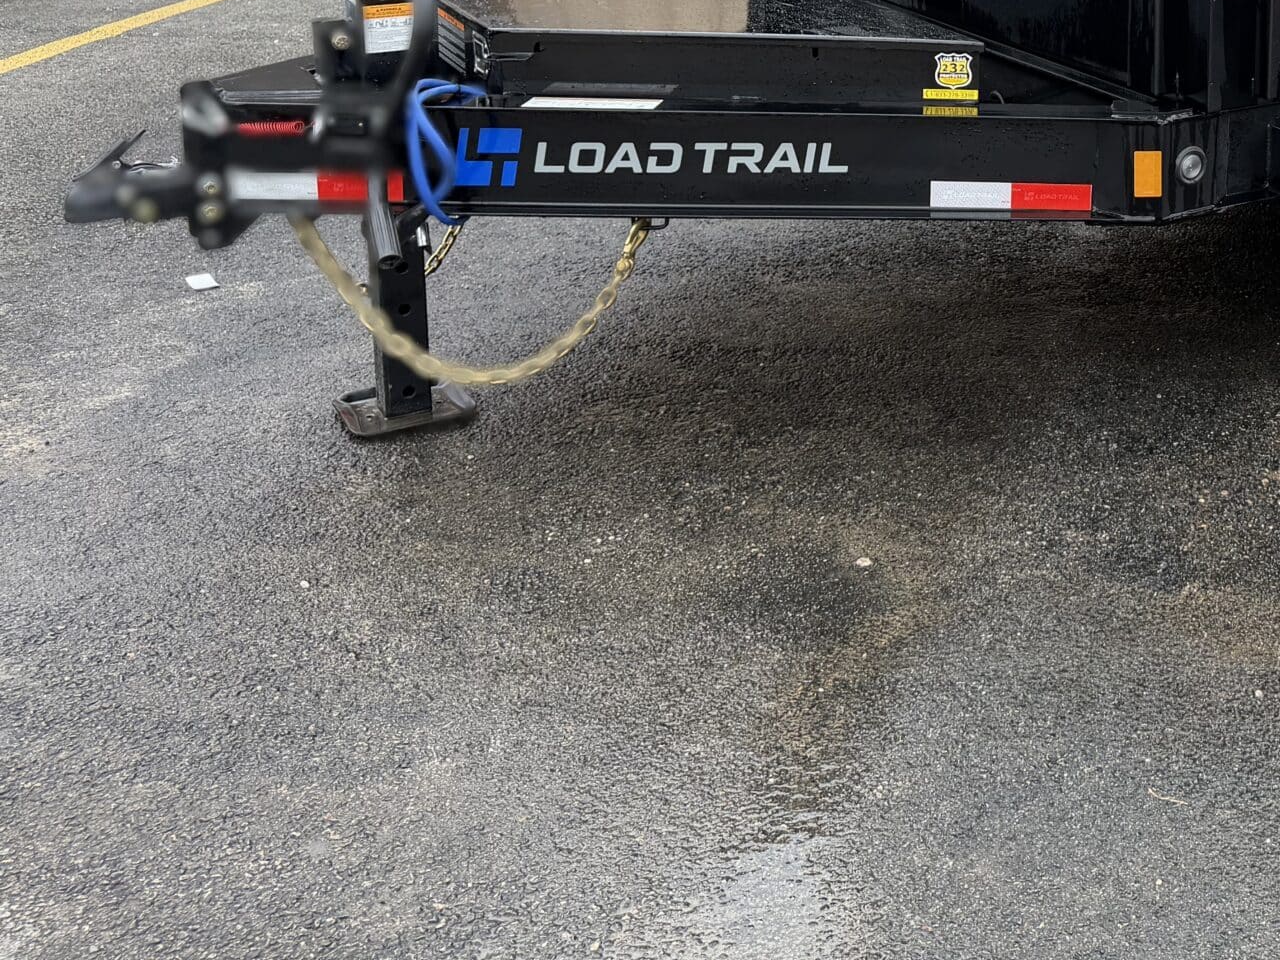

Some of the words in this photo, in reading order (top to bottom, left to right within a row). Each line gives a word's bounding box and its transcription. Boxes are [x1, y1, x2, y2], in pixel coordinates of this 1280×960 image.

[942, 63, 966, 74] 232
[534, 141, 684, 174] LOAD
[694, 141, 849, 174] TRAIL
